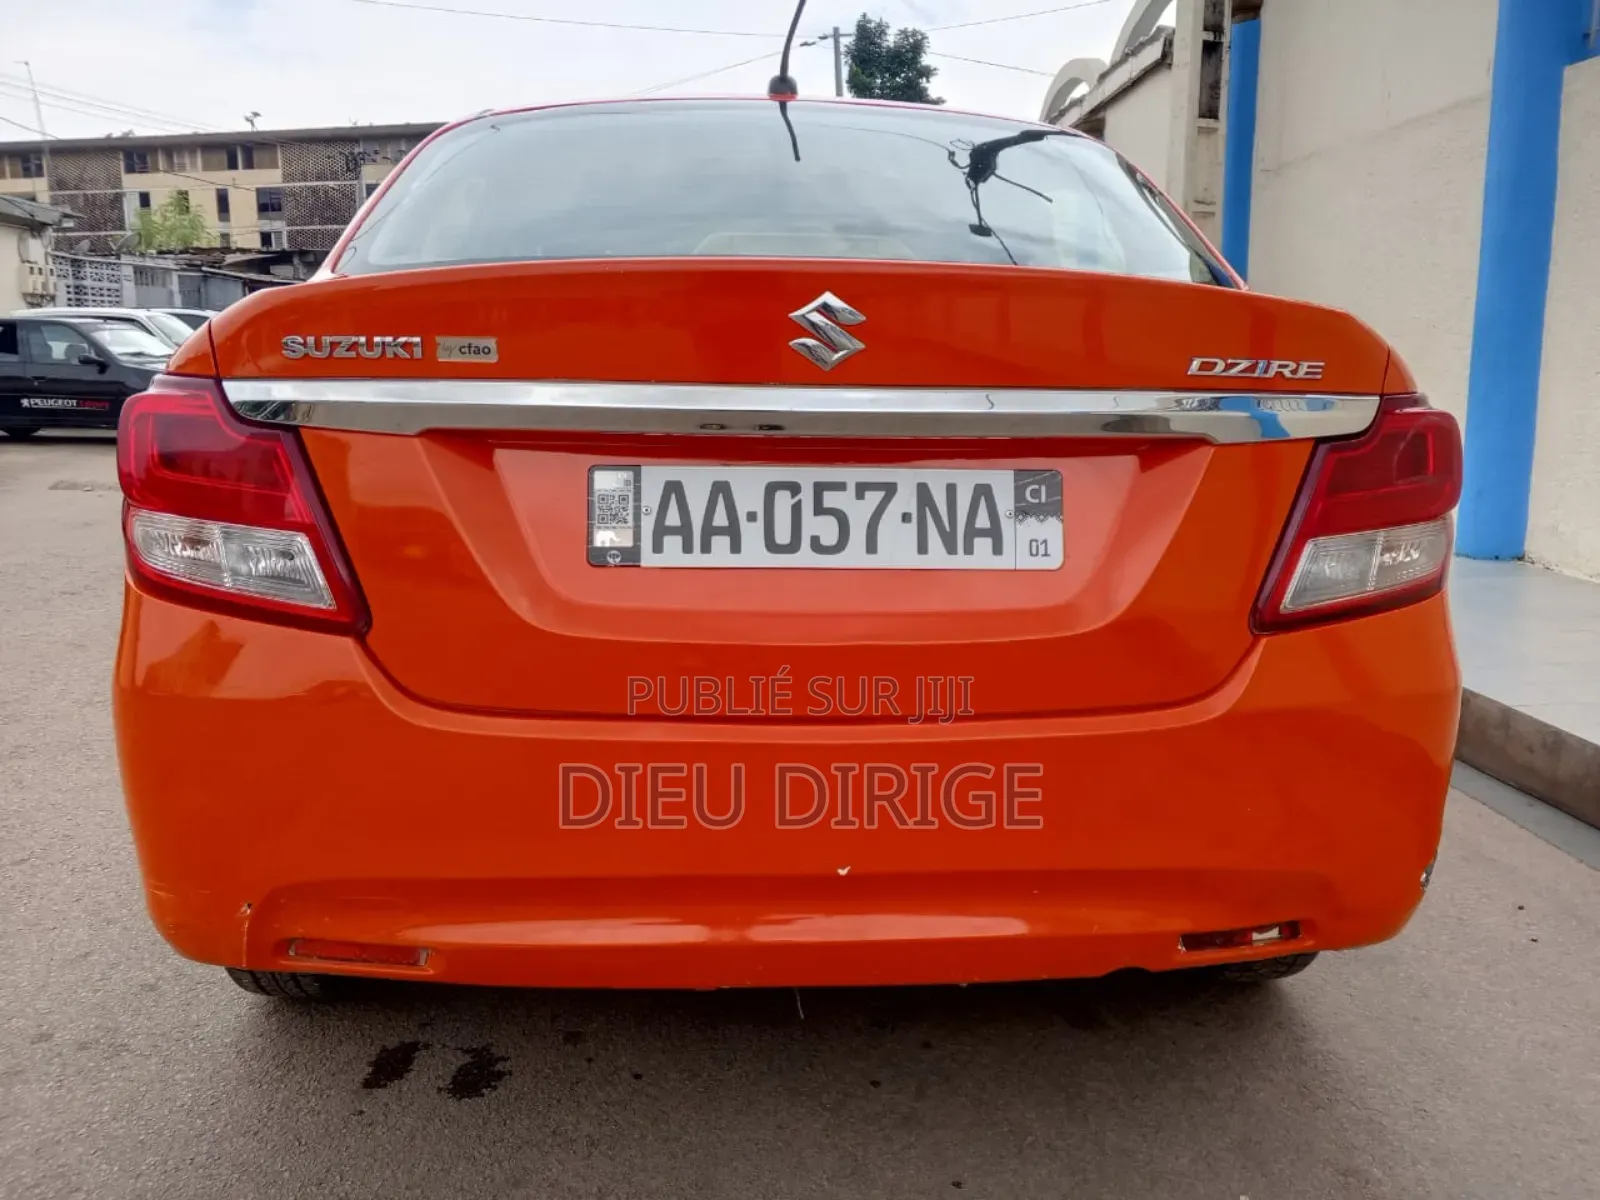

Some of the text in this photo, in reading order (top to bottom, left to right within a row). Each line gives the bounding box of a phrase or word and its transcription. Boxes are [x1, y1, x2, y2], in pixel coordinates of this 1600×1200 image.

[281, 335, 423, 360] SUZUKI
[458, 341, 491, 355] cfao
[1187, 357, 1326, 379] DZIRE
[30, 398, 77, 407] PEUGEOT
[1025, 484, 1046, 504] CI
[1029, 538, 1051, 558] 01
